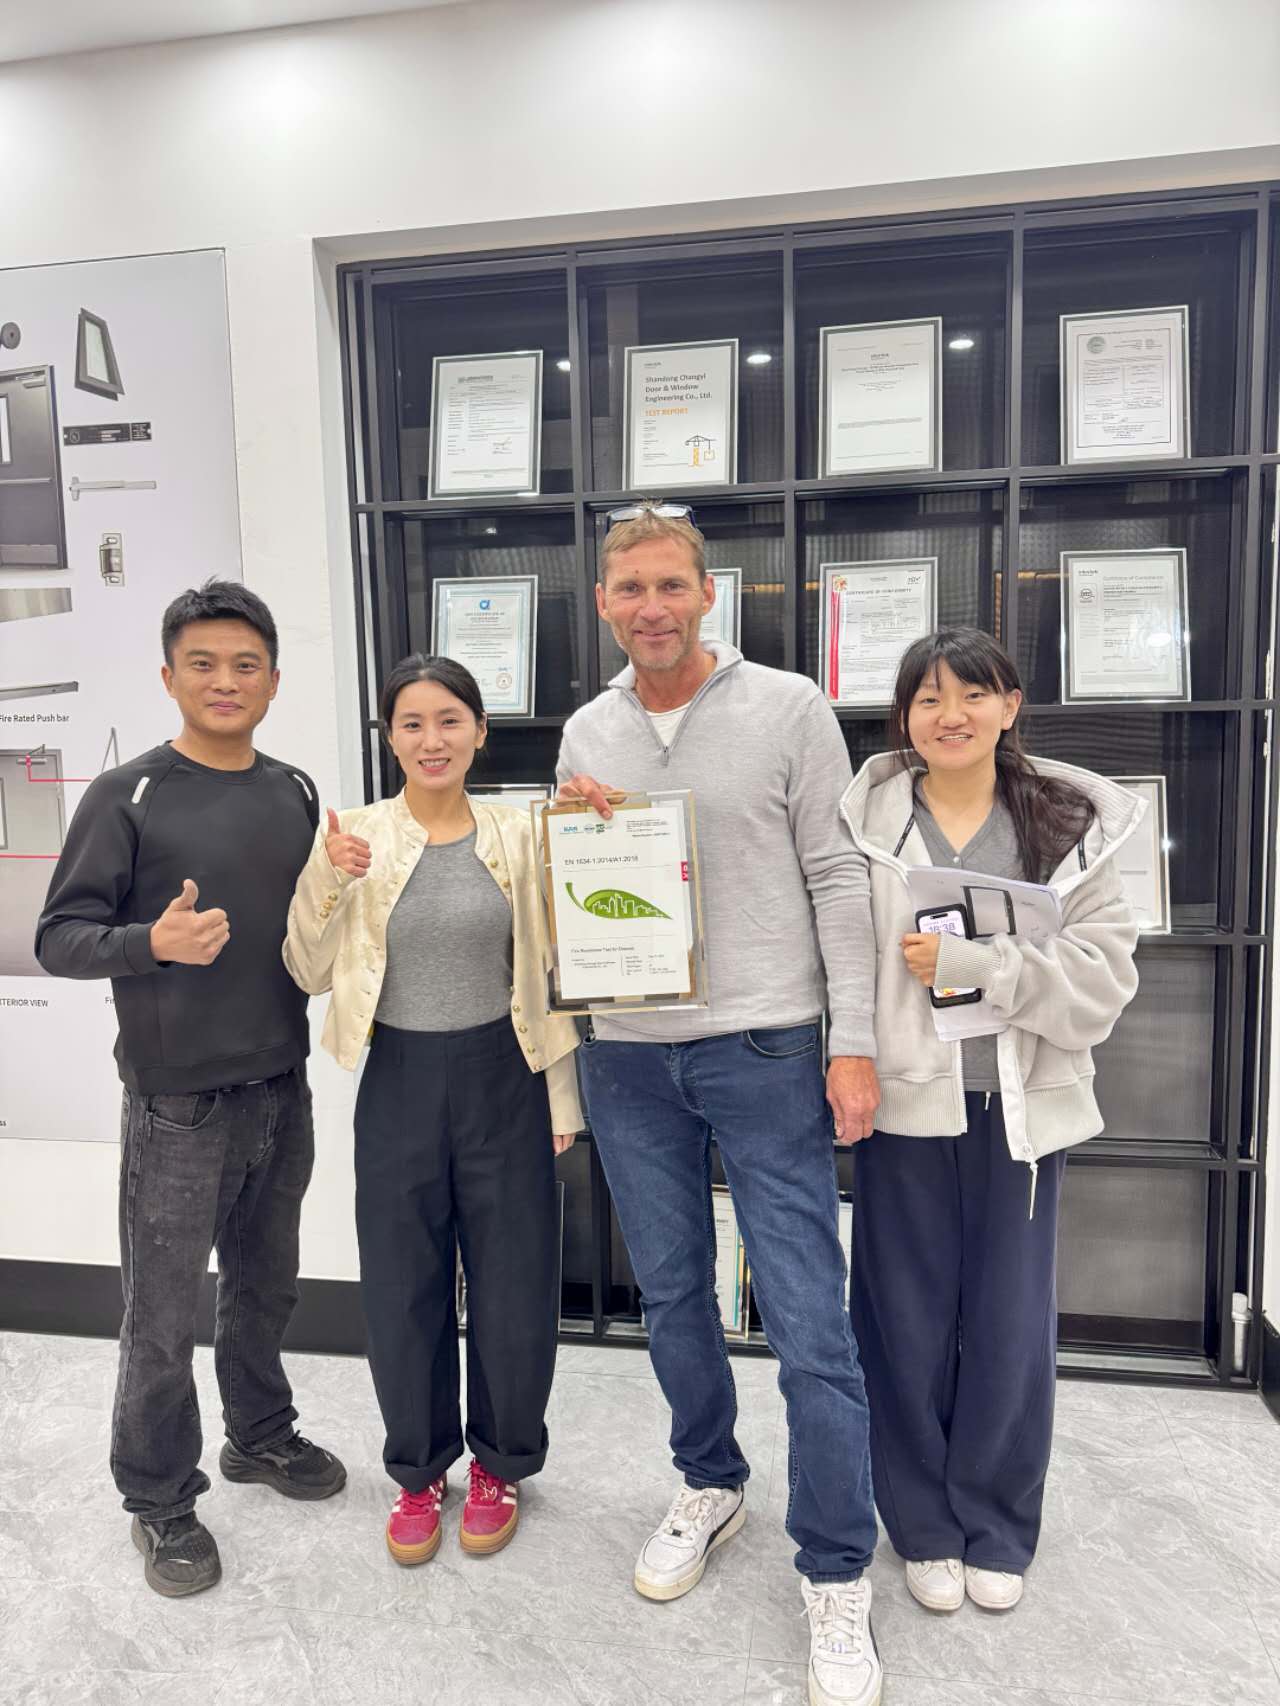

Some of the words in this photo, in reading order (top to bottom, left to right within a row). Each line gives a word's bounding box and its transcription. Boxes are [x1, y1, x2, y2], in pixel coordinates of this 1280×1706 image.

[13, 713, 35, 722] Rated
[36, 713, 55, 722] Push
[56, 712, 70, 722] bar
[29, 999, 49, 1007] VIEW
